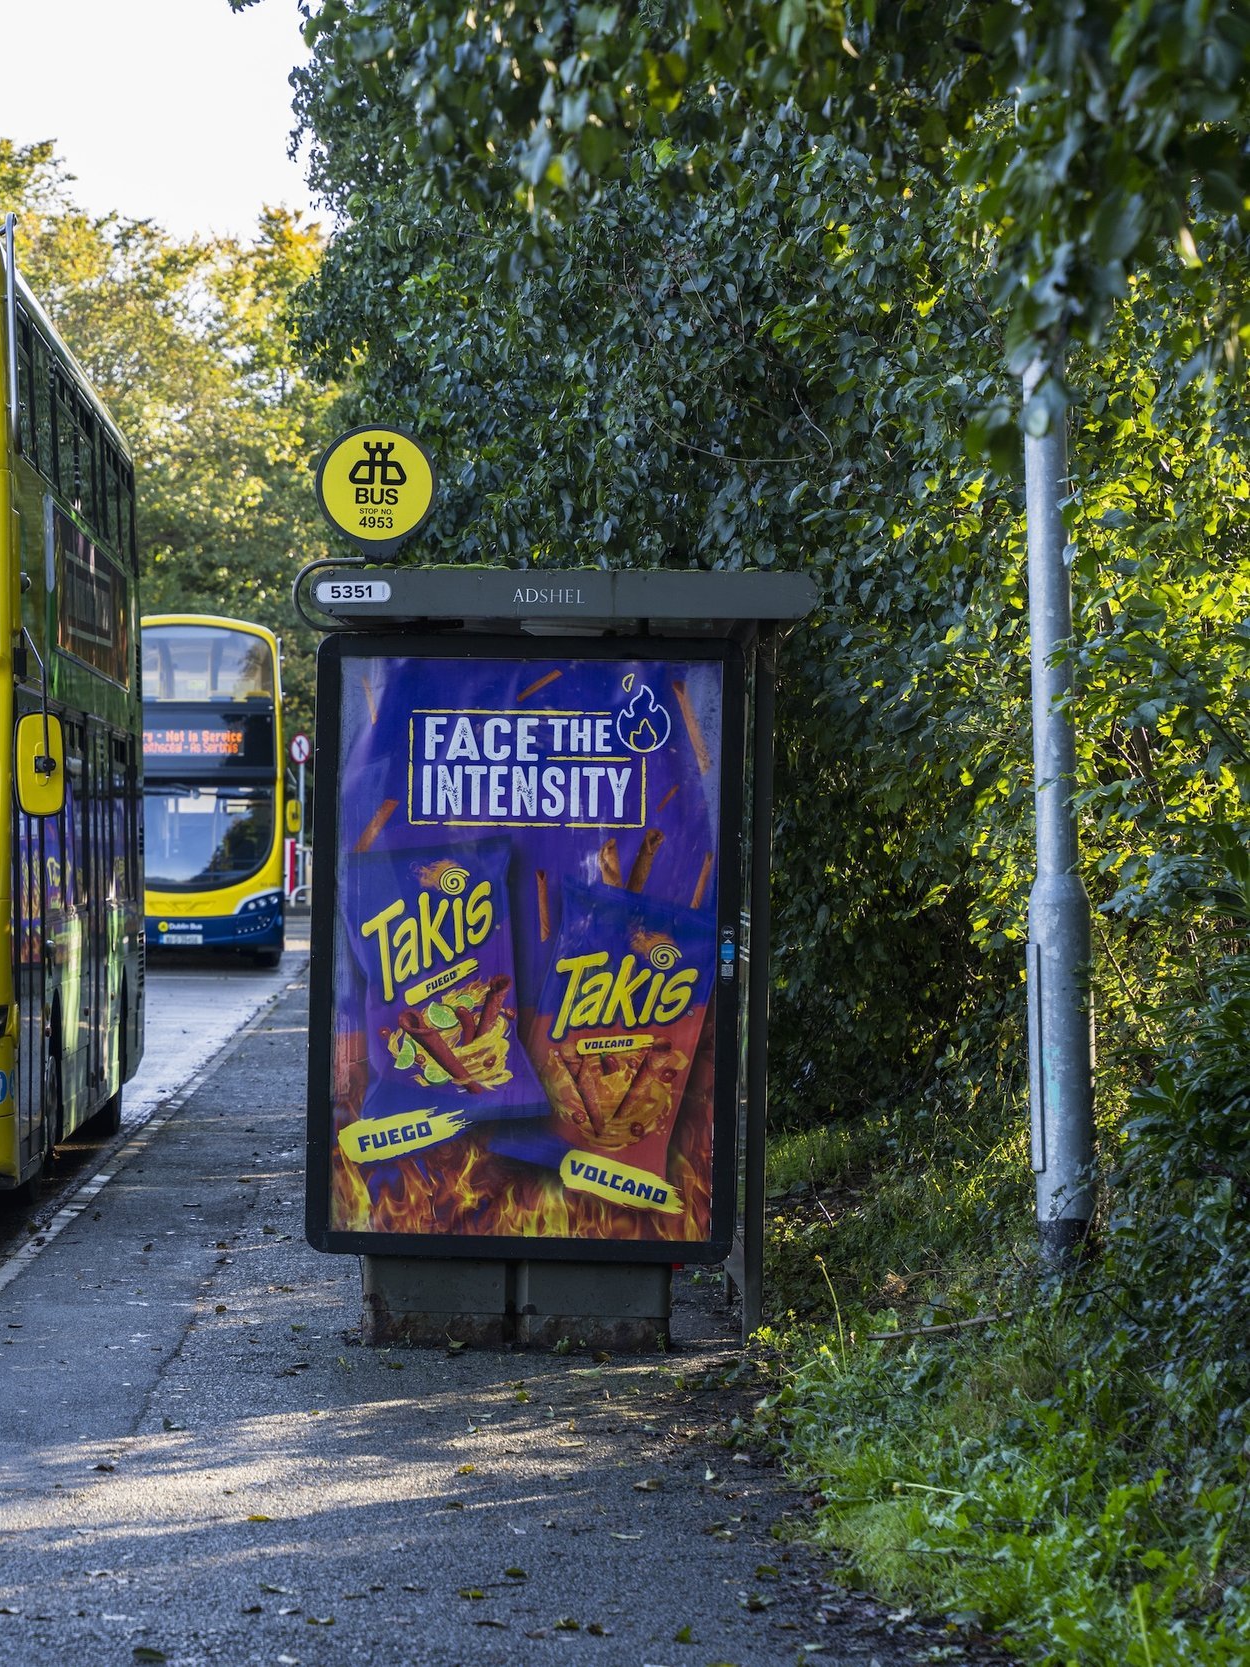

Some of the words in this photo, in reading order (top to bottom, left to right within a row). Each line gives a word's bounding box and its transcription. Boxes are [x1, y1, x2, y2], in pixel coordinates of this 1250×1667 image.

[355, 487, 398, 505] BUS
[359, 516, 393, 528] 4953
[331, 585, 372, 598] 5351
[513, 588, 585, 604] ADSHEL
[166, 729, 185, 742] Not
[202, 730, 242, 743] Service
[424, 716, 539, 762] FACE
[548, 718, 613, 753] THE
[422, 765, 632, 818] INTENSITY
[361, 868, 493, 1002] Takis
[425, 971, 458, 993] FUEGO
[551, 943, 699, 1040] Takis
[584, 1038, 634, 1050] VOLCANO
[357, 1121, 433, 1153] FUEGO
[570, 1160, 668, 1205] VOLCANO
